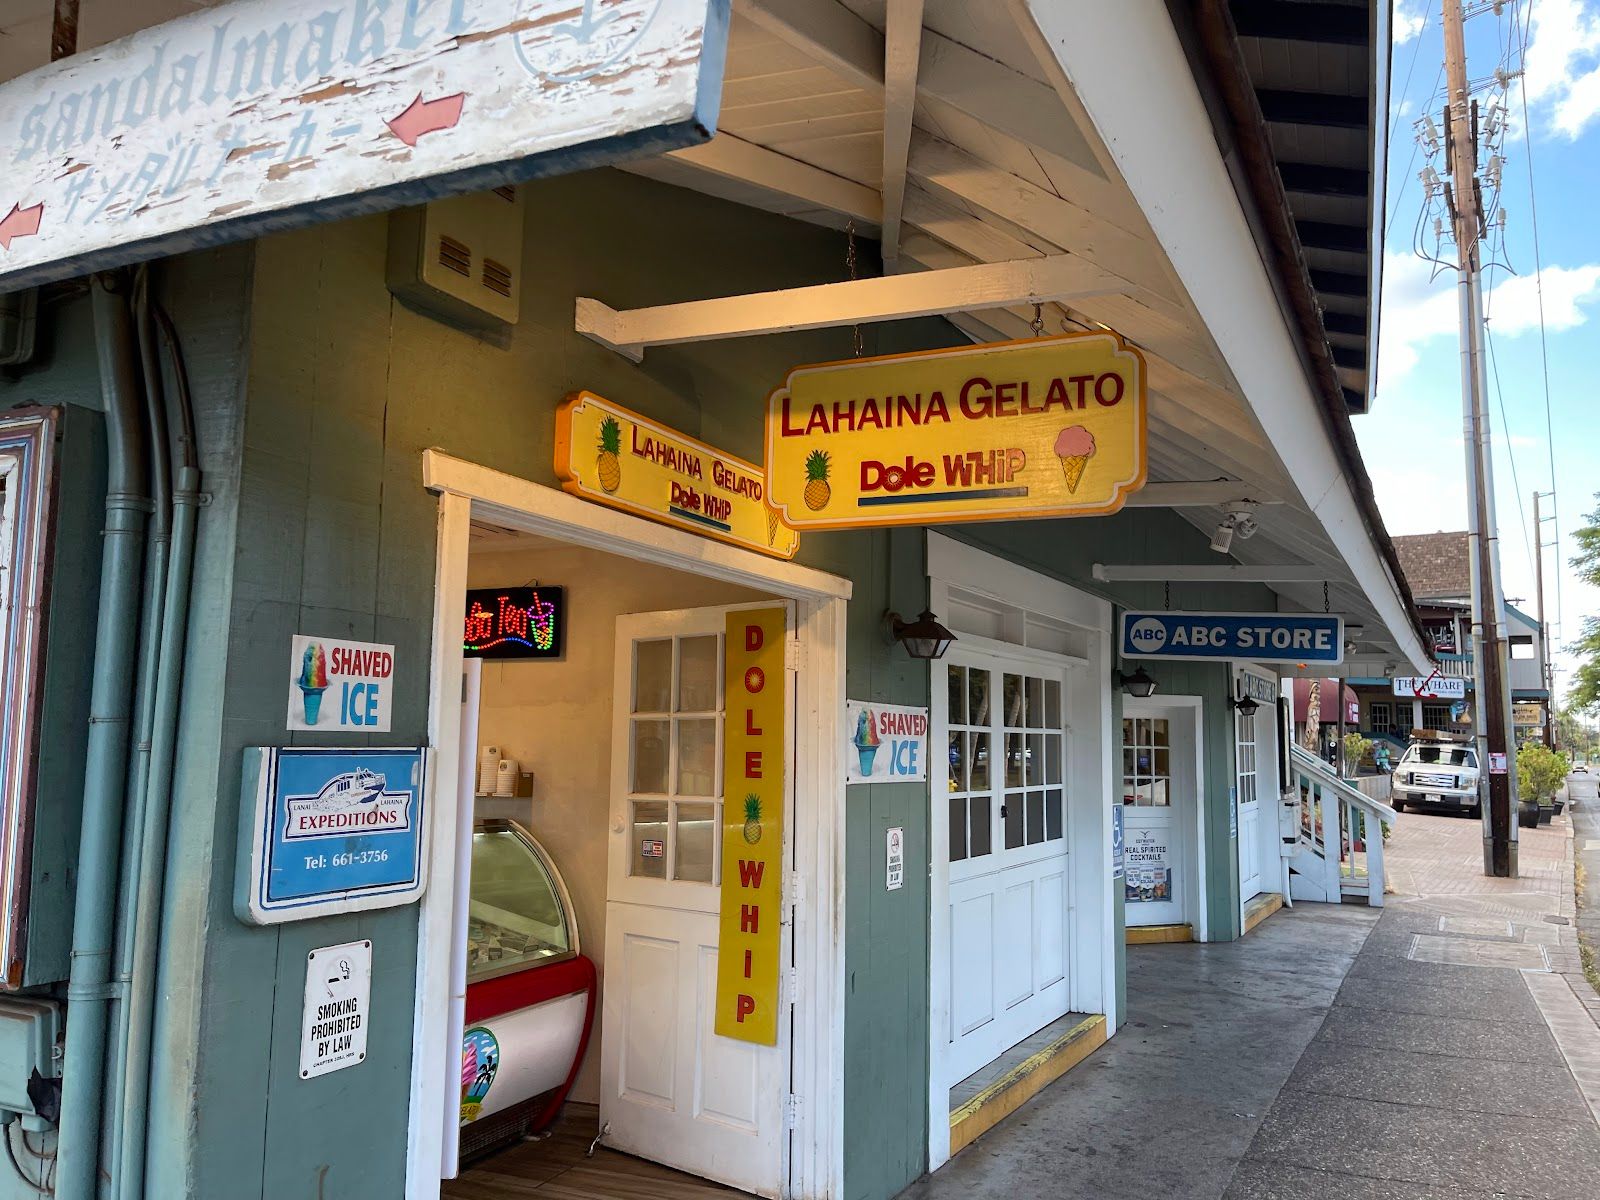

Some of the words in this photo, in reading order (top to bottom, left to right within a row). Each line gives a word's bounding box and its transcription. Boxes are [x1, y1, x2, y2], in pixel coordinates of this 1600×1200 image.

[781, 391, 950, 438] LAHAINA
[960, 372, 1125, 419] GELATO
[632, 424, 702, 480] LAHAINA
[713, 461, 762, 501] GELATO
[860, 455, 936, 492] Dole
[670, 481, 701, 510] Dole
[1133, 628, 1164, 641] ABC
[1171, 625, 1227, 647] ABC
[1236, 627, 1332, 650] STORE
[331, 647, 392, 678] SHAVED
[1396, 679, 1418, 691] THE
[1421, 680, 1463, 692] WHARF
[340, 682, 379, 726] ICE
[744, 624, 765, 779] DOLE
[880, 712, 927, 736] SHAVED
[889, 740, 919, 775] ICE
[299, 810, 398, 830] EXPEDITIONS
[304, 855, 327, 870] Tel:
[332, 849, 389, 867] 661-3756
[1125, 846, 1140, 854] REAL
[736, 859, 765, 1023] WHIP
[317, 997, 357, 1021] SMOKING
[311, 1014, 361, 1041] PROHIBITED
[318, 1040, 330, 1057] BY
[333, 1034, 352, 1053] LAW
